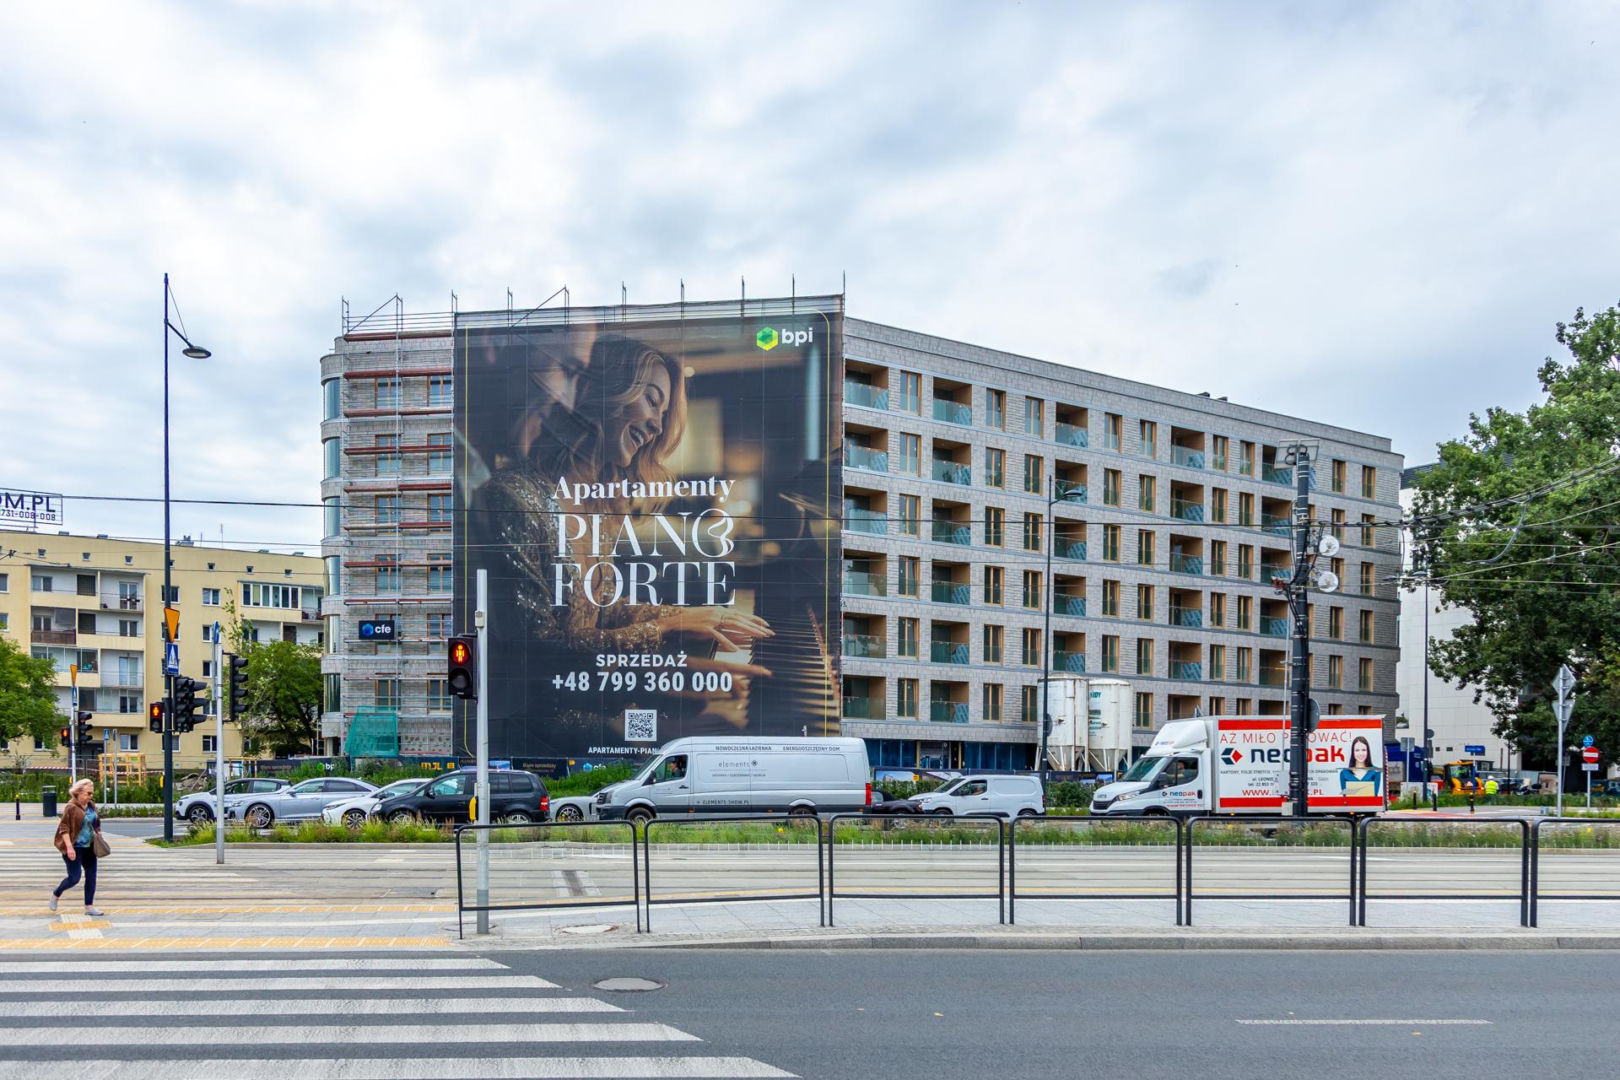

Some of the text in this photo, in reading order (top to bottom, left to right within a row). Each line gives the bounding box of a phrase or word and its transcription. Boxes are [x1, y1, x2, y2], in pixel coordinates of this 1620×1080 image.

[781, 327, 814, 347] bpi
[552, 475, 736, 505] Apartamenty
[0, 492, 56, 513] M.PL
[553, 508, 736, 558] PIANO
[550, 561, 736, 608] FORTE
[374, 624, 392, 634] cfe
[595, 650, 688, 668] SPRZEDAŻ
[552, 671, 733, 692] +48 799 360 000
[1220, 730, 1353, 744] AŻ MIŁO POWAĆ!
[587, 746, 660, 755] APARTAMENTY-PIAN
[1169, 790, 1197, 798] neopak
